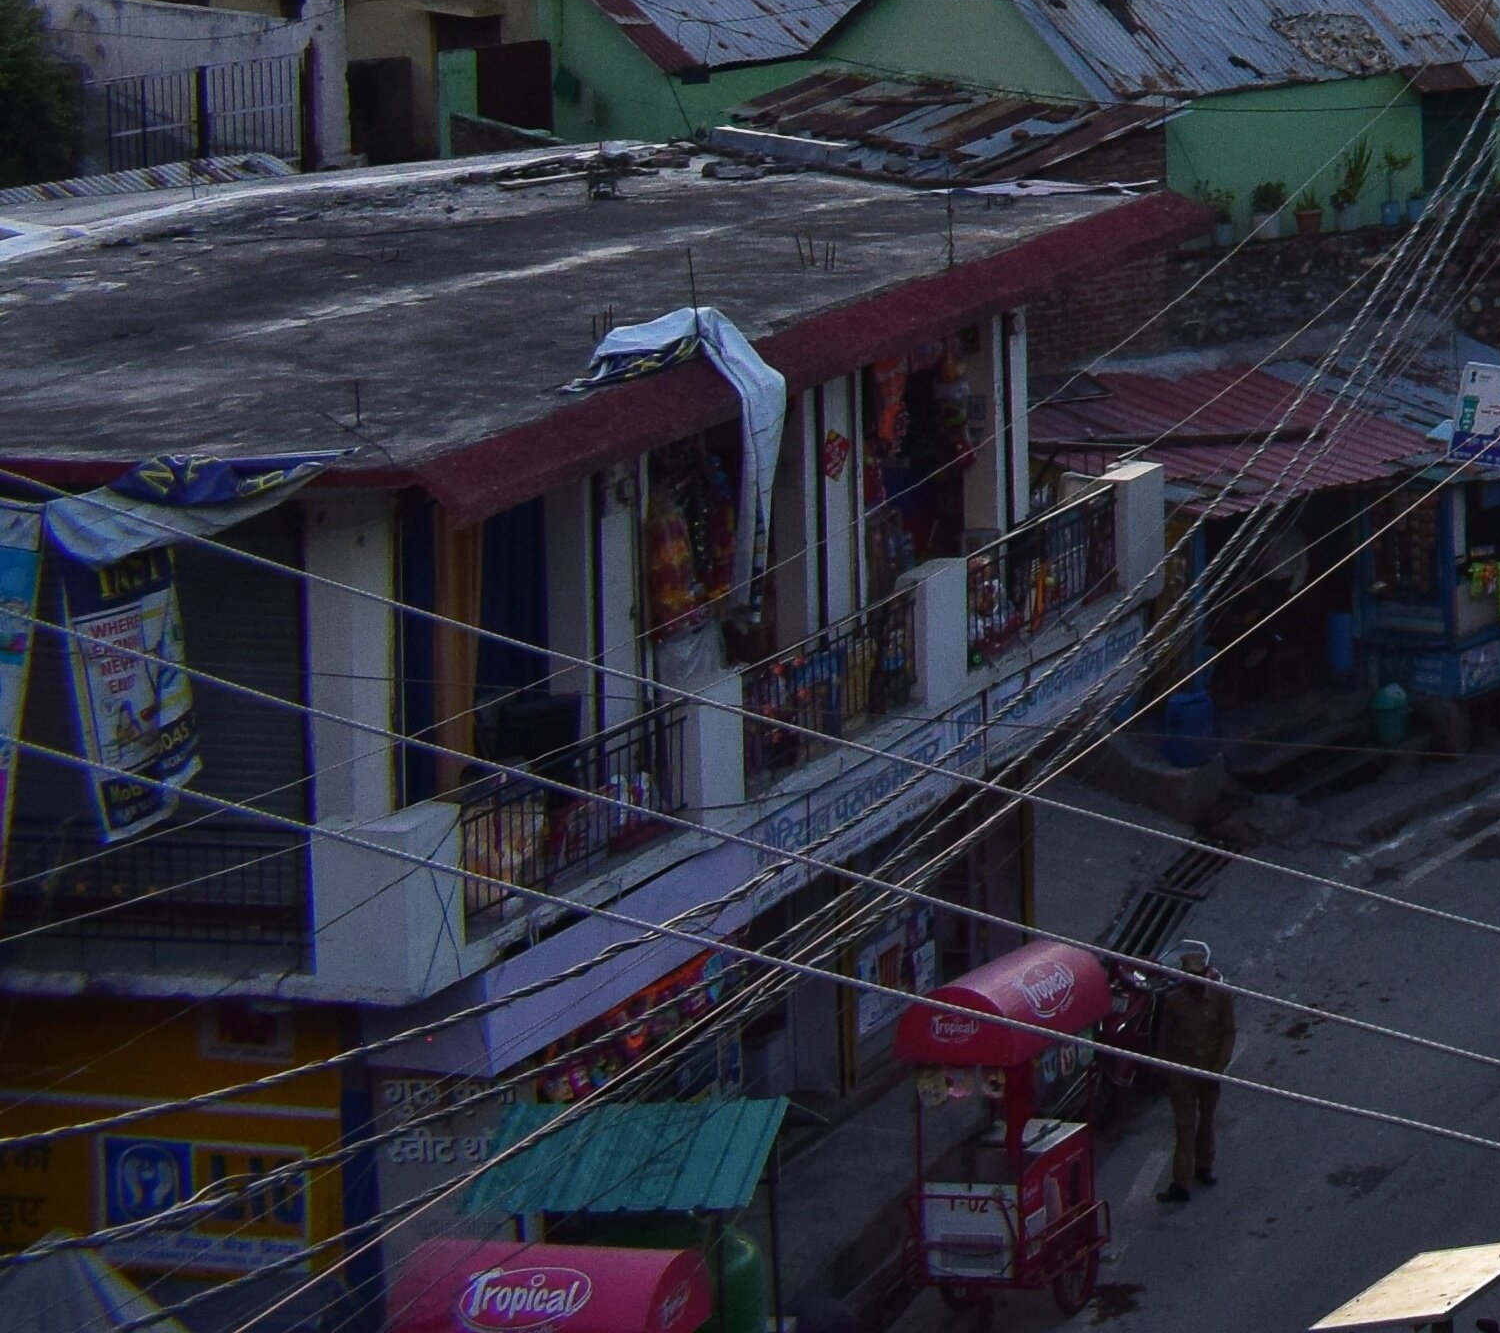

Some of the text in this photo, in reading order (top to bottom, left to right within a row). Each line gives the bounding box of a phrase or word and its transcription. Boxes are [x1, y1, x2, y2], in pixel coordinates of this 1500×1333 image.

[90, 614, 141, 639] WHERE
[931, 1013, 977, 1038] Tropical
[385, 1126, 458, 1164] स्वीट
[209, 1153, 304, 1223] LIC
[468, 1267, 584, 1320] Tropical
